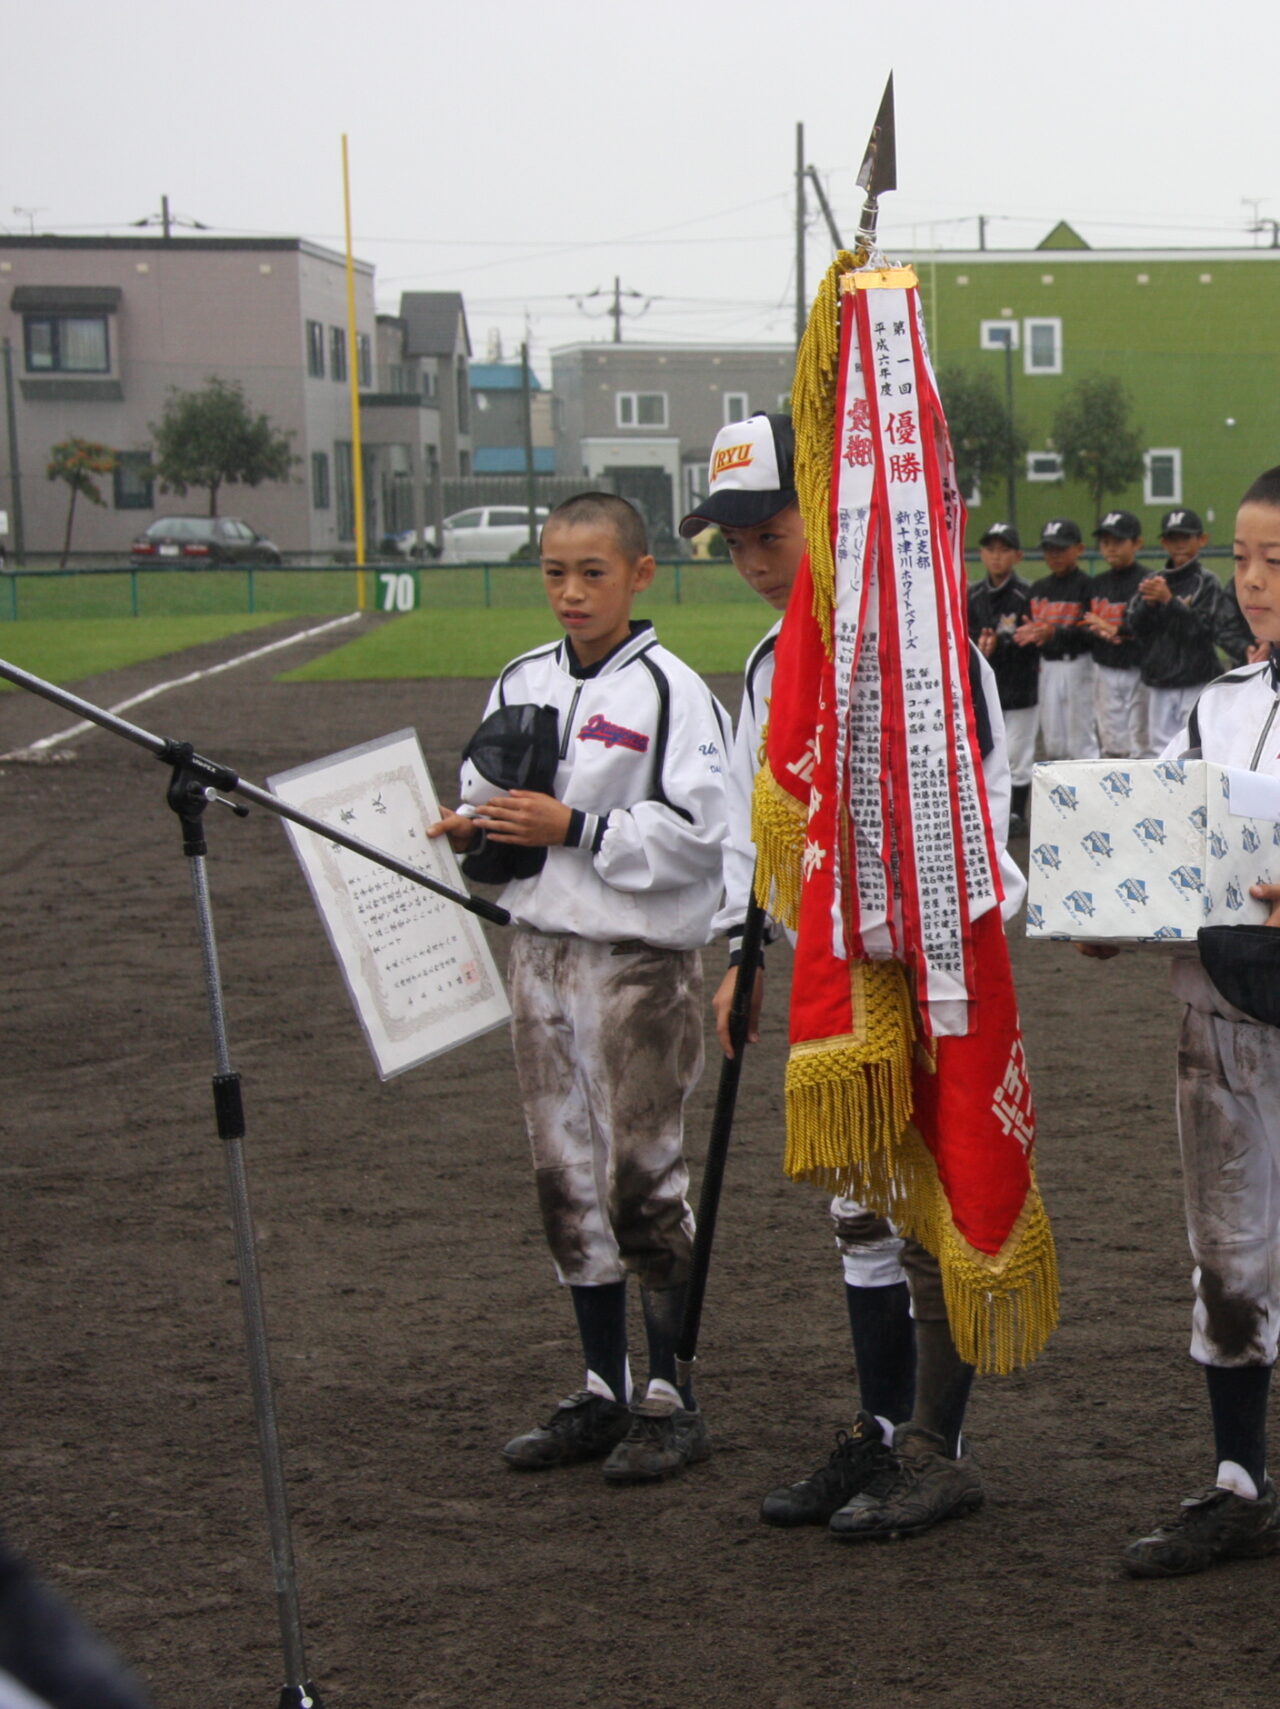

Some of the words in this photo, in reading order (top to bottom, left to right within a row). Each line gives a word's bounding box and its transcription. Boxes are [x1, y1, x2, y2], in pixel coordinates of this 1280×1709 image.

[873, 321, 893, 397] 平成六年度
[893, 320, 912, 395] 第一回
[884, 410, 924, 485] 優勝
[913, 508, 931, 570] 空知支部
[1166, 511, 1185, 527] M
[380, 573, 416, 612] 70
[895, 510, 919, 650] 新十津川ホワイトベアーズ
[905, 668, 929, 680] 監督
[908, 698, 931, 708] コーチ
[910, 744, 931, 756] 選手
